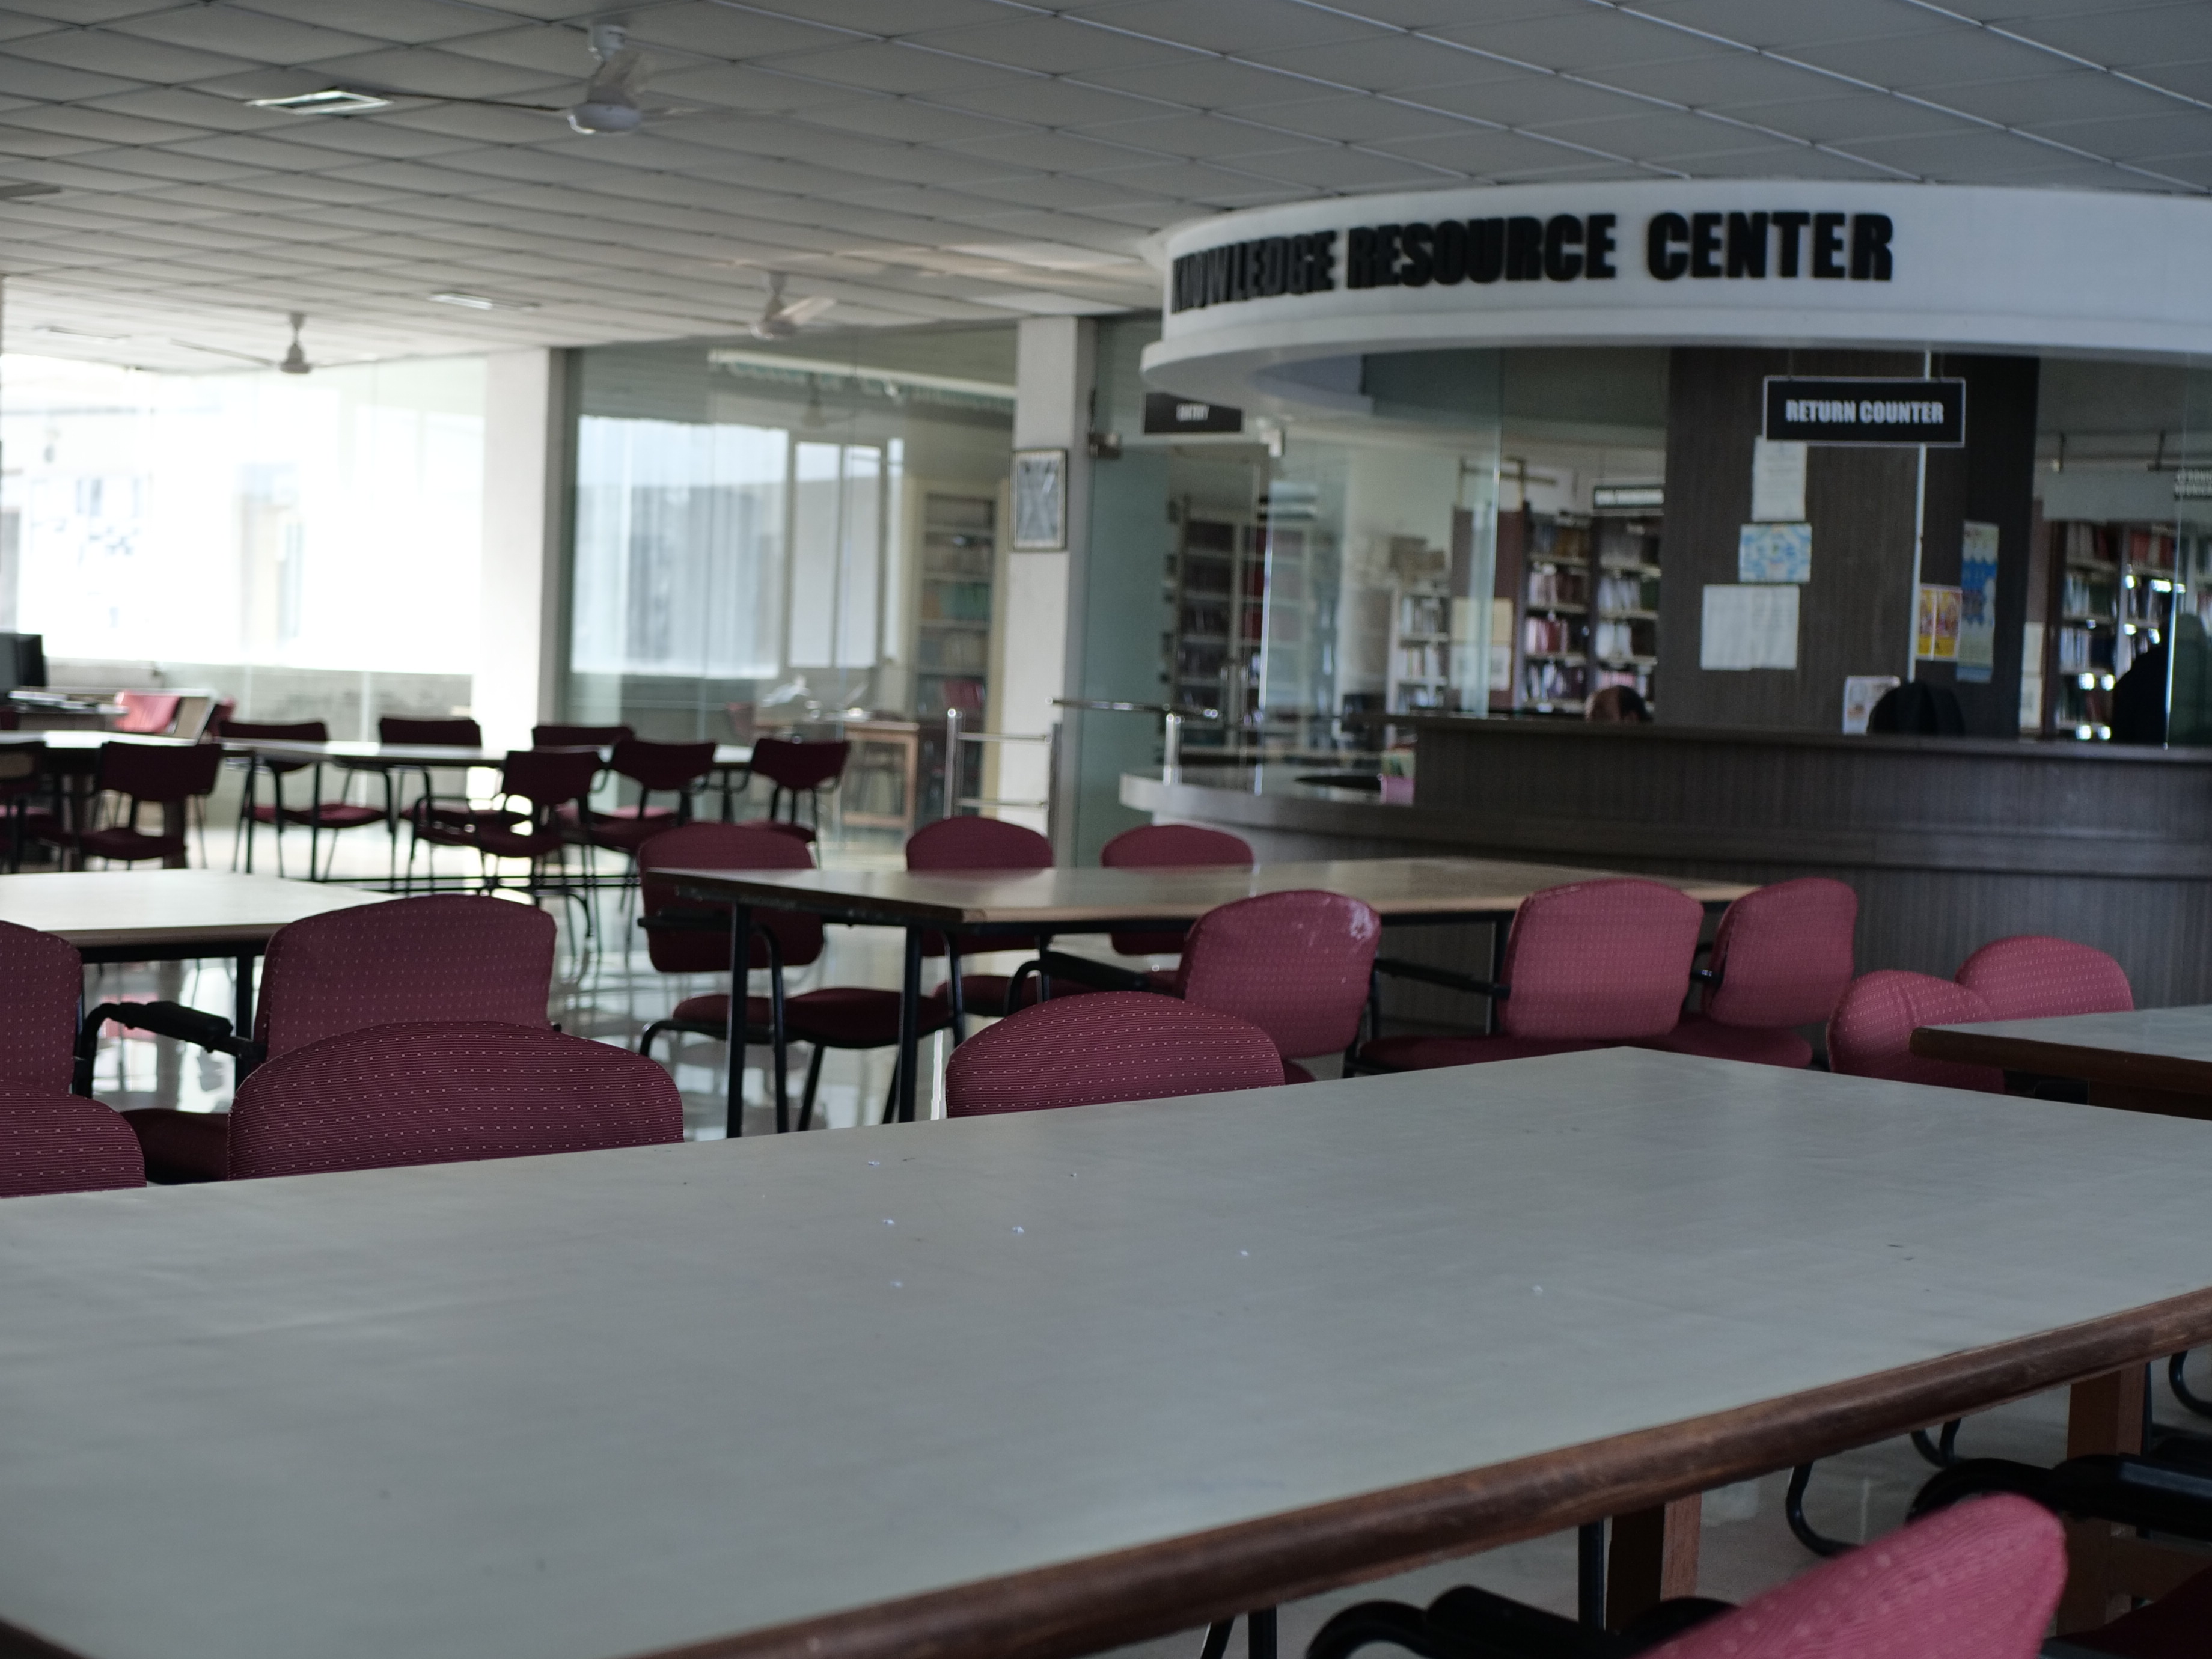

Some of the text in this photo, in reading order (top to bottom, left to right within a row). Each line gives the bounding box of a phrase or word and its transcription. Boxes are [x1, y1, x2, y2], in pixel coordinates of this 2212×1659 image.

[1346, 213, 1617, 289] RESOURCE
[1646, 211, 1893, 281] CENTER
[1785, 399, 1945, 424] RETURN COUNTER
